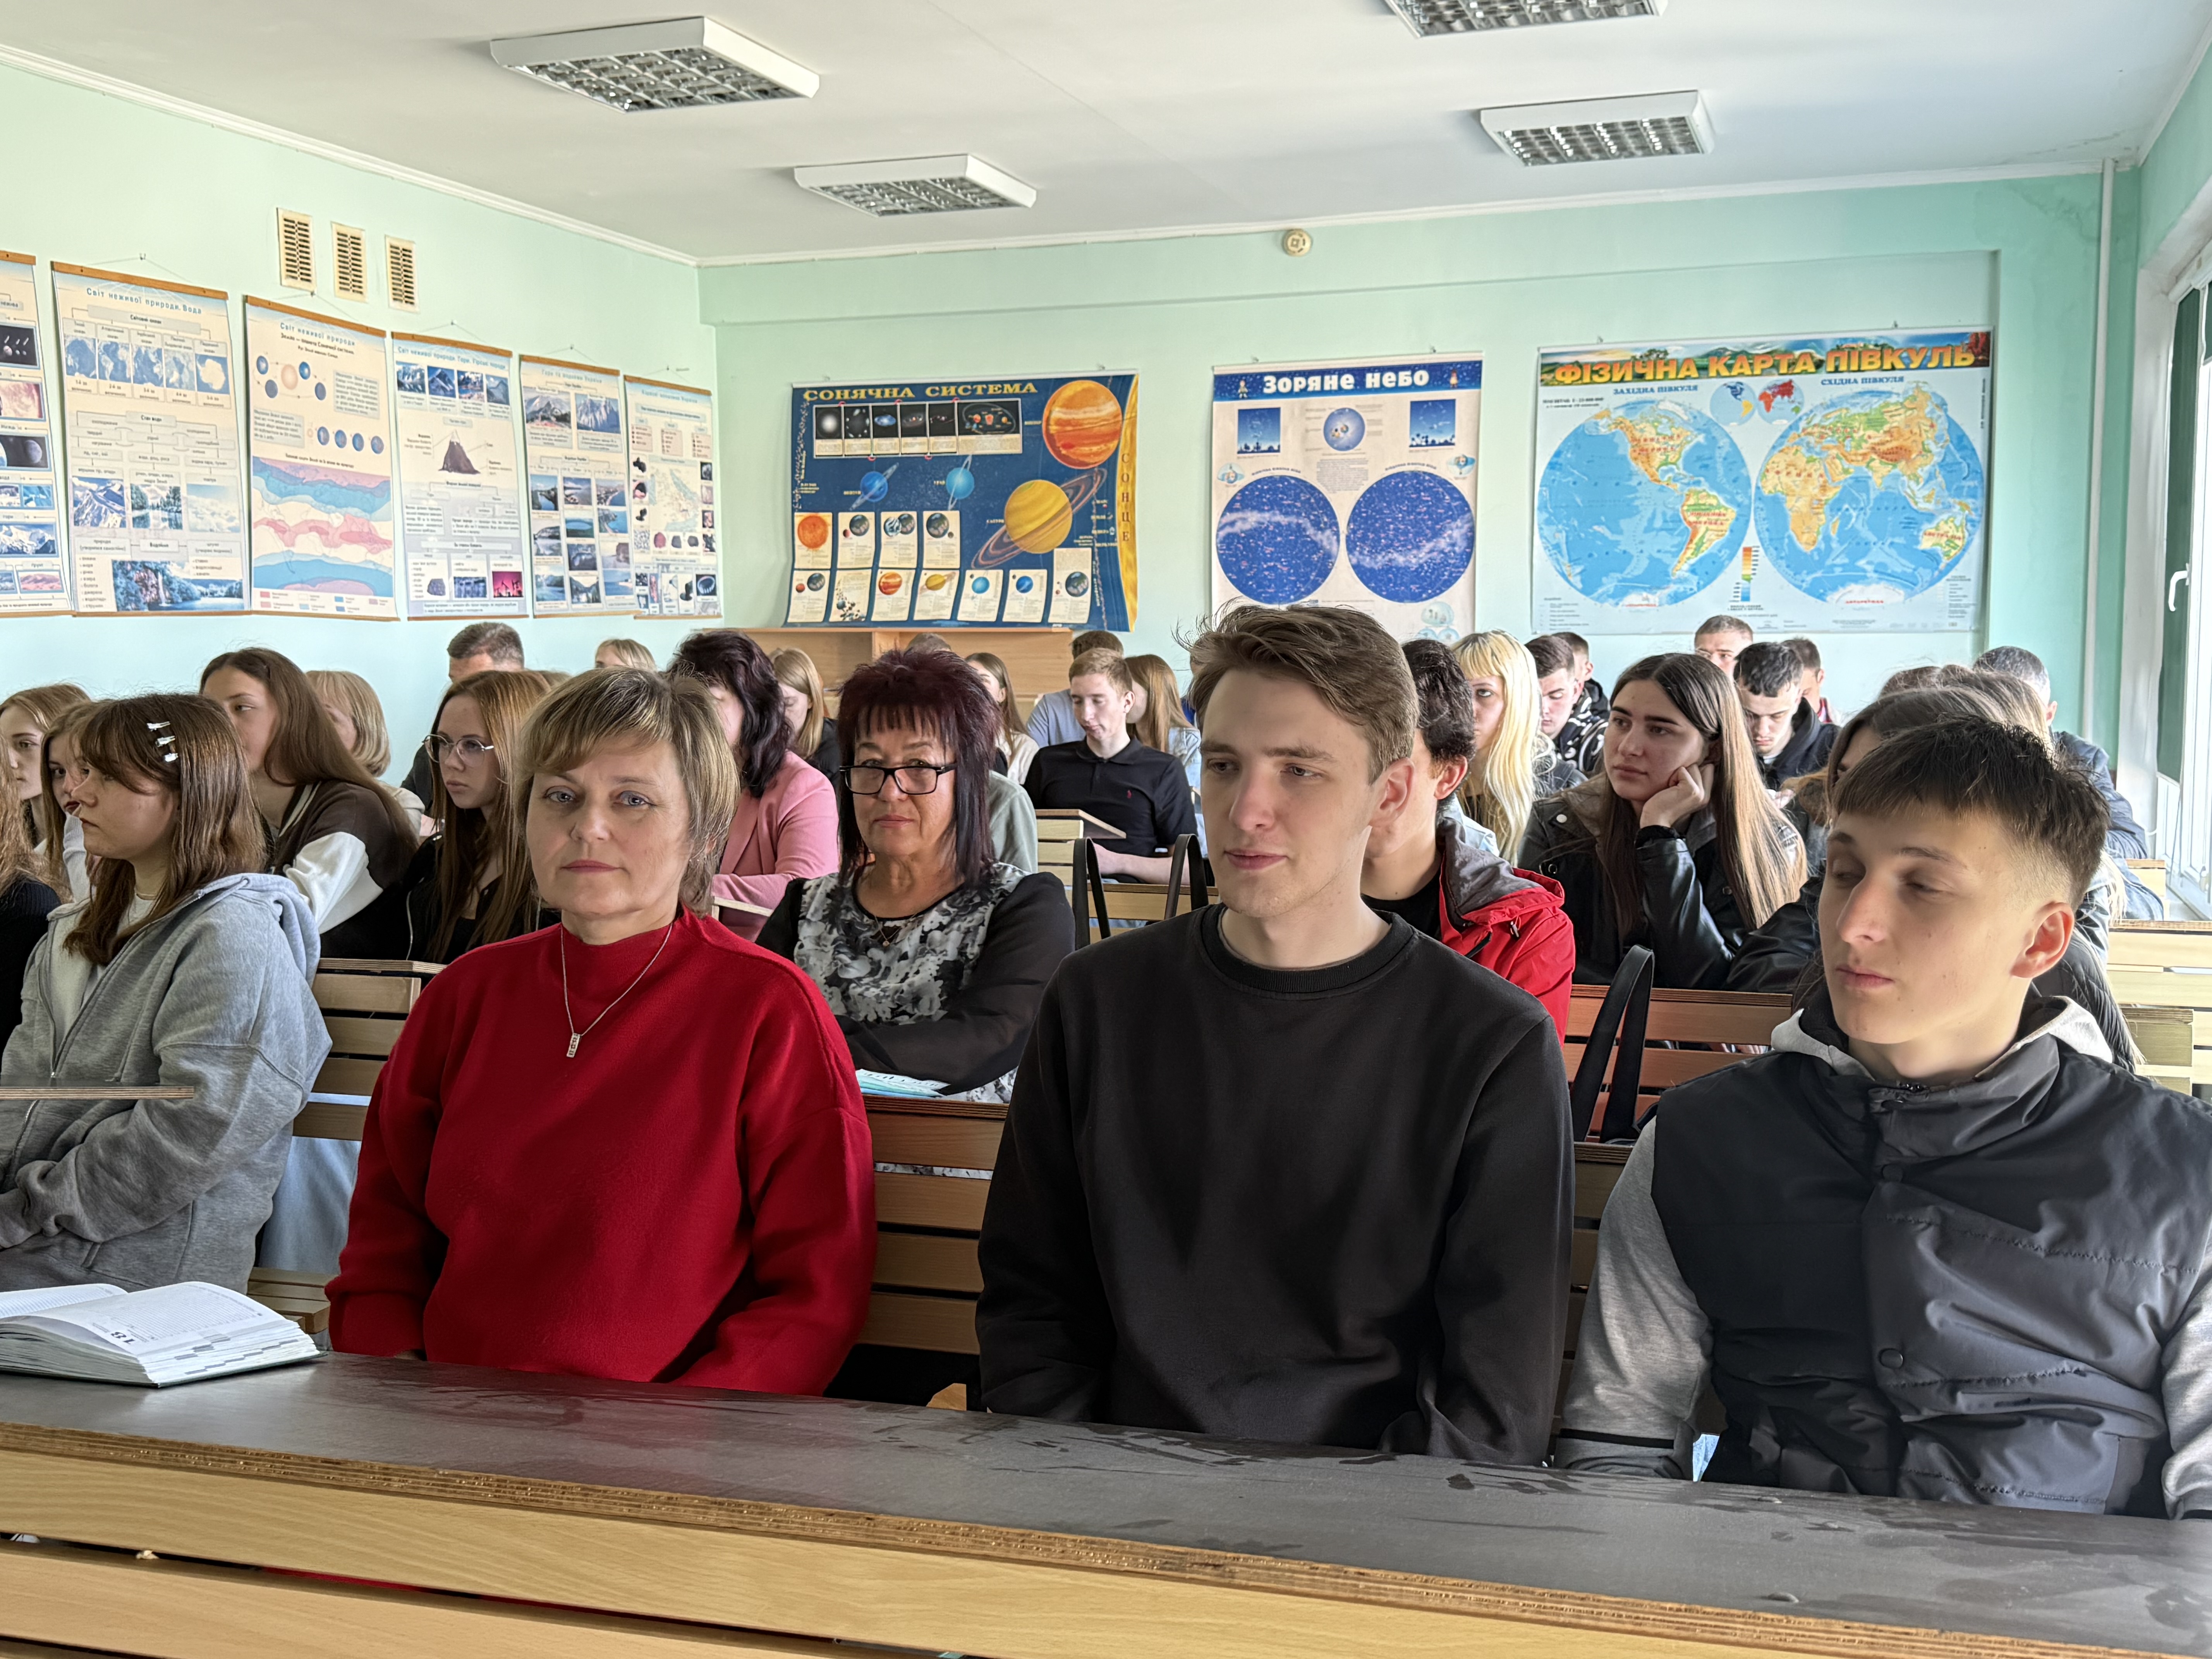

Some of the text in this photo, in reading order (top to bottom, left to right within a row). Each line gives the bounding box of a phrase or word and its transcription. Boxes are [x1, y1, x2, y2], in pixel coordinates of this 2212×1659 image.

[87, 287, 105, 298] Світ
[109, 293, 142, 304] неживої
[183, 304, 202, 314] Вода
[280, 322, 355, 346] Світ неживої природи
[410, 349, 431, 357] неживої
[1555, 345, 1975, 385] ФІЗИЧНА КАРТА ПІВКУЛЬ
[804, 382, 1038, 401] СОНЯЧНА СИСТЕМА
[1263, 374, 1355, 394] Зоряне
[1657, 385, 1698, 393] ПІВКУЛЯ
[1121, 453, 1130, 541] СОНЦЕ
